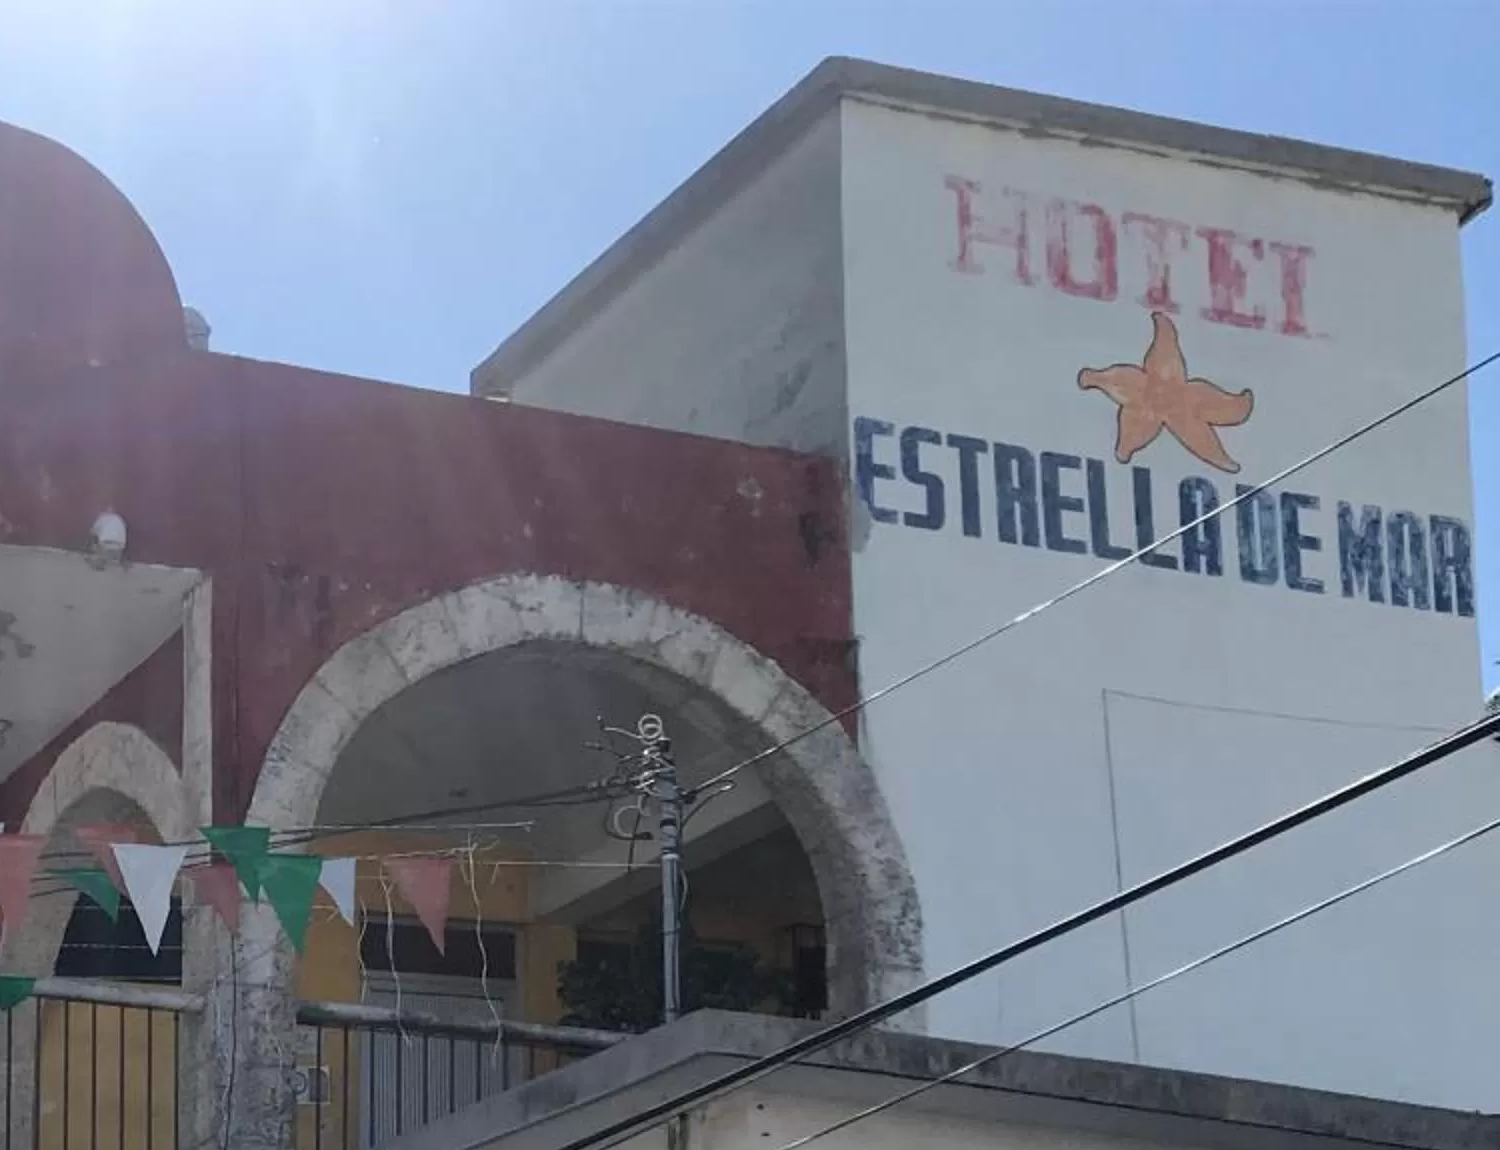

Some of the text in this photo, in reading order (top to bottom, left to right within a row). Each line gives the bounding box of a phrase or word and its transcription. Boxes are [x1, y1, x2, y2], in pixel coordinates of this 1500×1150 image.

[853, 416, 1475, 617] ESTRELLA DE MAR
